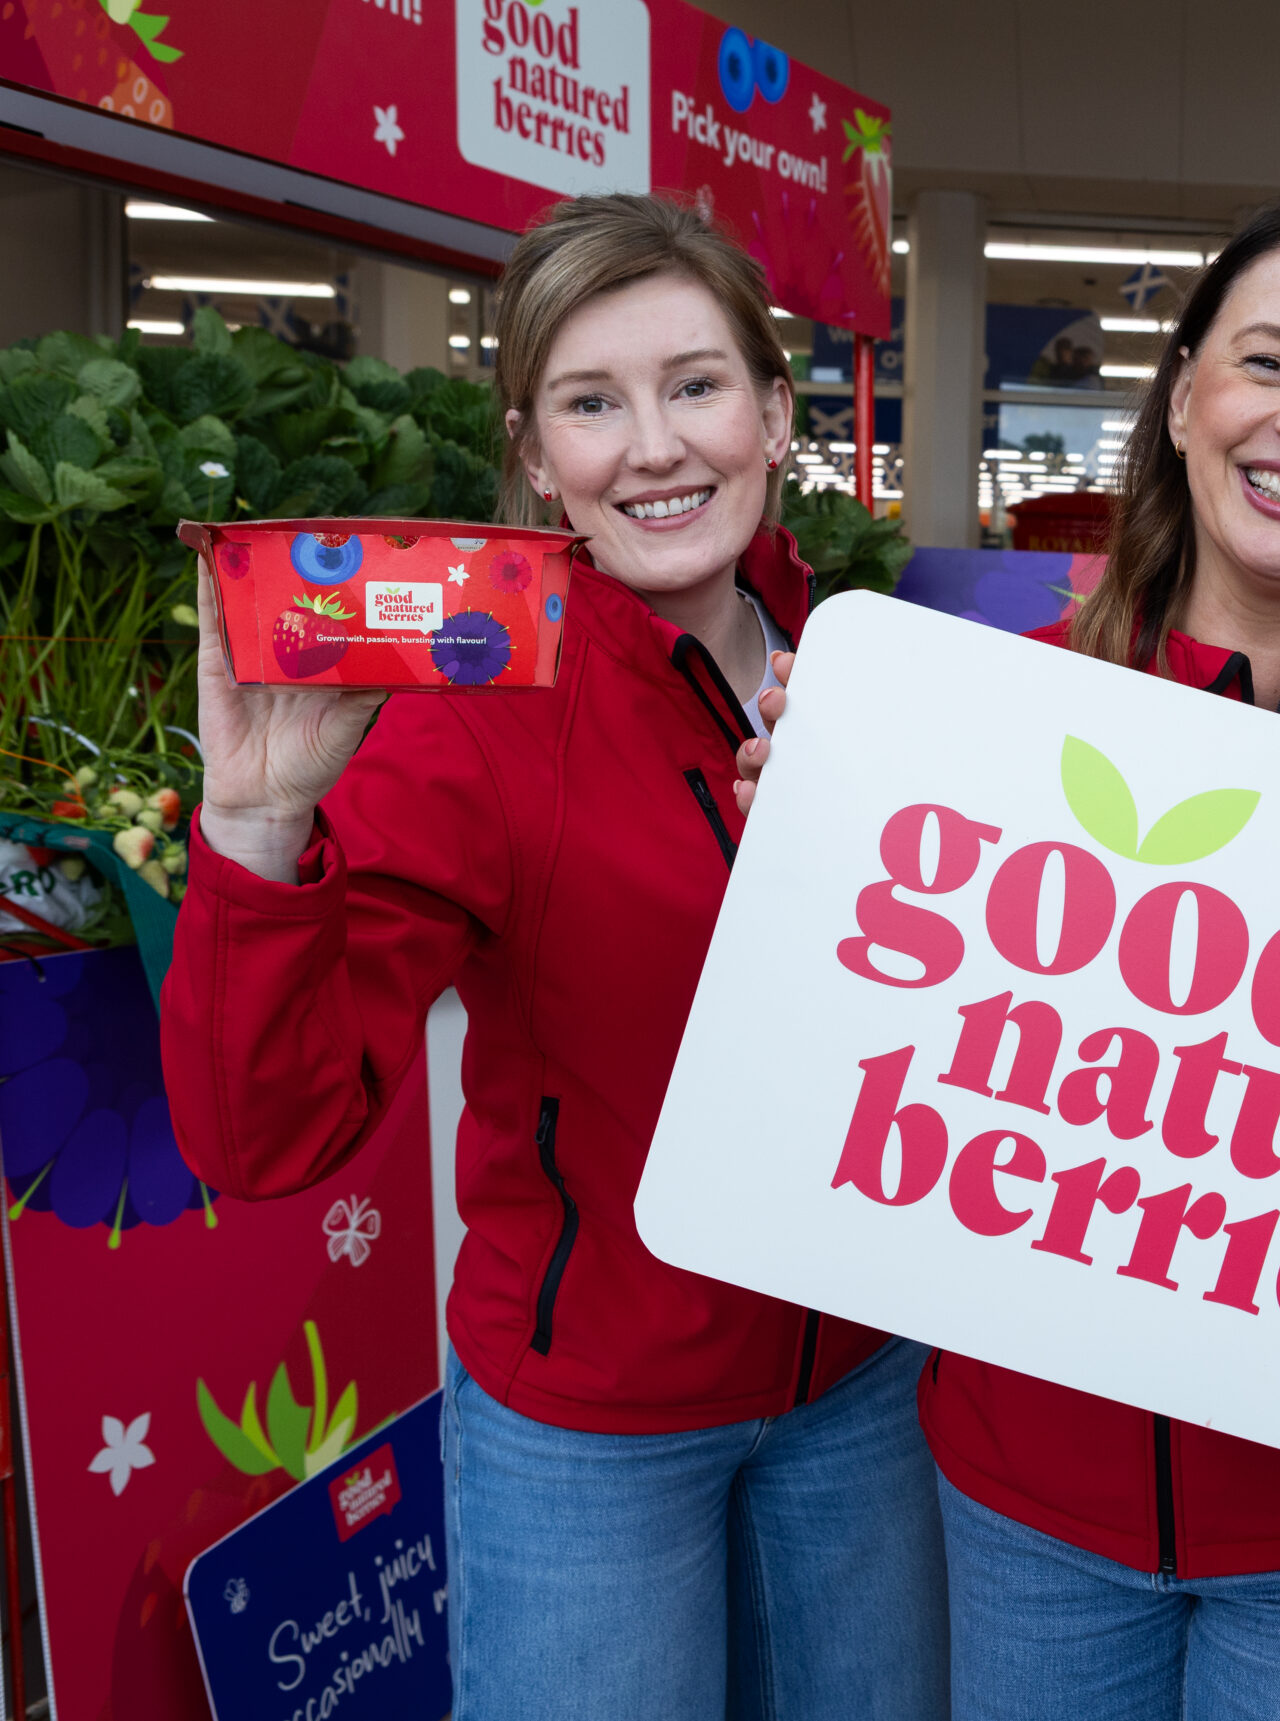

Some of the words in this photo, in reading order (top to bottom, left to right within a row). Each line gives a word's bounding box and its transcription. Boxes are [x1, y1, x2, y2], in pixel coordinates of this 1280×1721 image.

[482, 0, 580, 70] good
[493, 77, 606, 167] berries
[508, 53, 630, 134] natured
[671, 90, 720, 149] Pick
[723, 120, 773, 168] your
[777, 150, 828, 193] own!
[375, 590, 413, 607] good
[379, 610, 423, 622] berries
[384, 602, 434, 613] natured
[316, 634, 345, 642] Grown
[346, 634, 365, 643] with
[366, 635, 400, 645] passion,
[401, 635, 435, 646] bursting
[435, 636, 455, 644] with
[456, 636, 487, 645] flavour!
[268, 1571, 371, 1691] Sweet,
[374, 1533, 437, 1624] juicy
